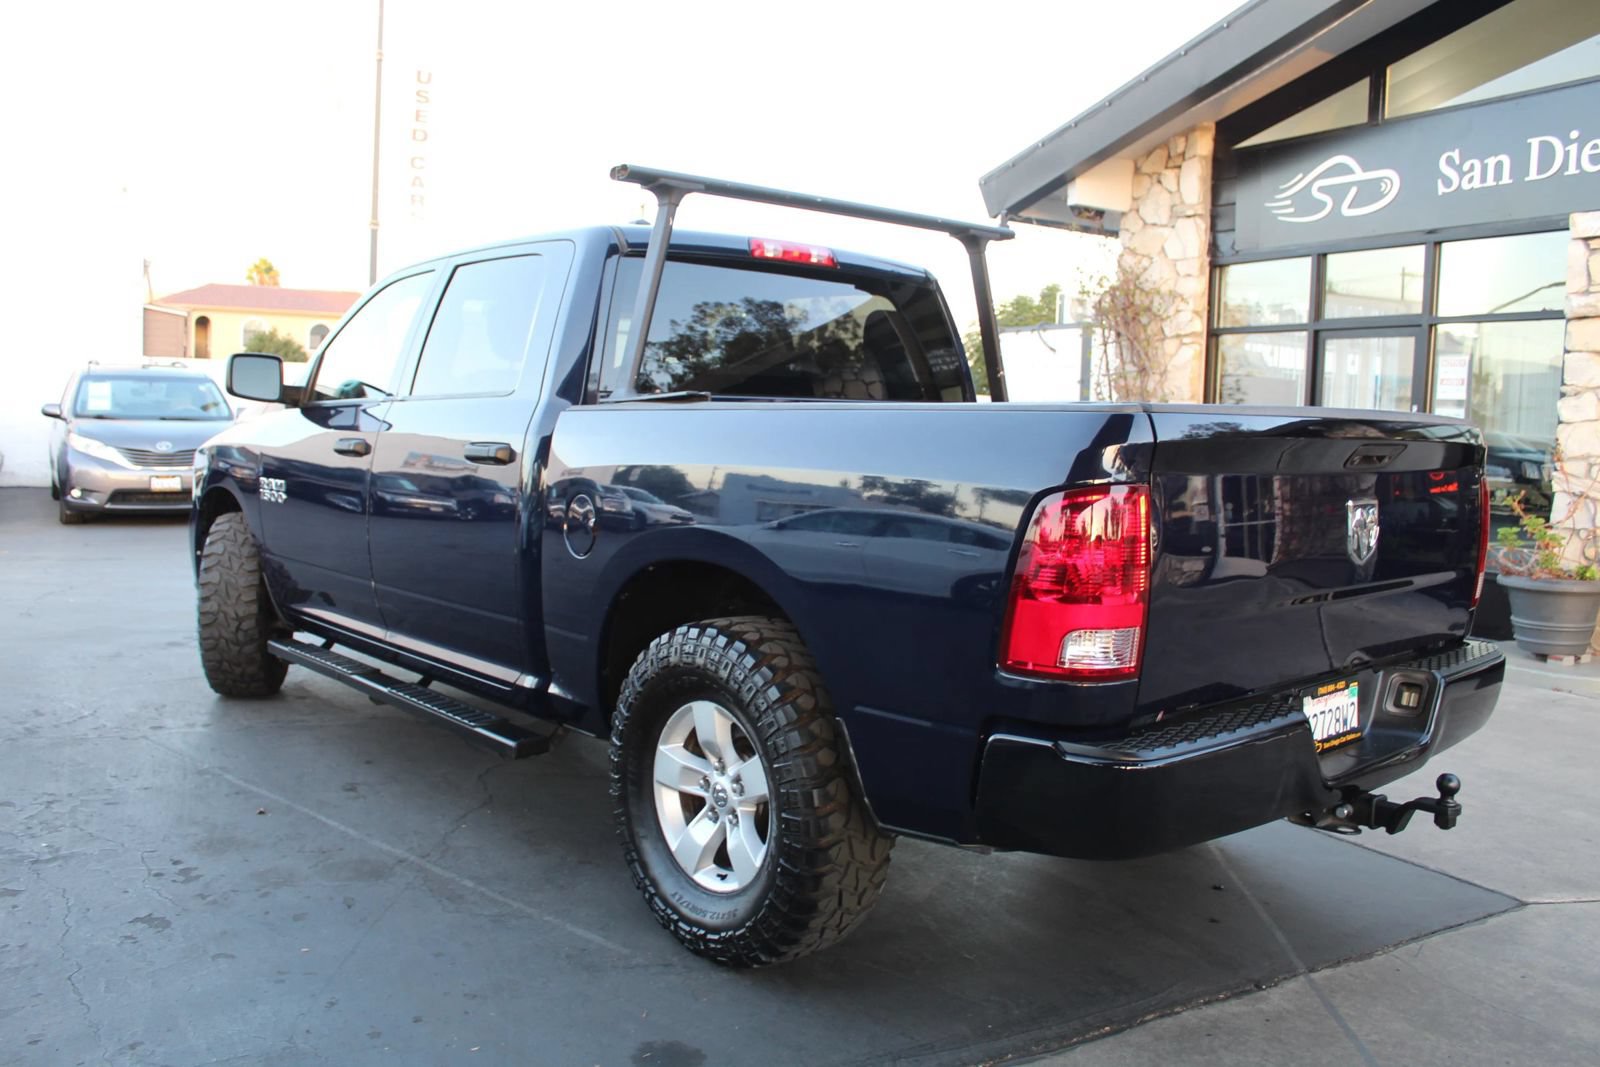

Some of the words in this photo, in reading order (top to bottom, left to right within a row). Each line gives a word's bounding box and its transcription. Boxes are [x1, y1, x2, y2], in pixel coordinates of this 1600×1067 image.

[412, 69, 433, 142] USED
[1436, 148, 1514, 196] San
[1523, 129, 1600, 182] Die
[259, 476, 286, 491] RAM
[259, 489, 288, 503] 1500
[1307, 701, 1356, 739] 2728W2
